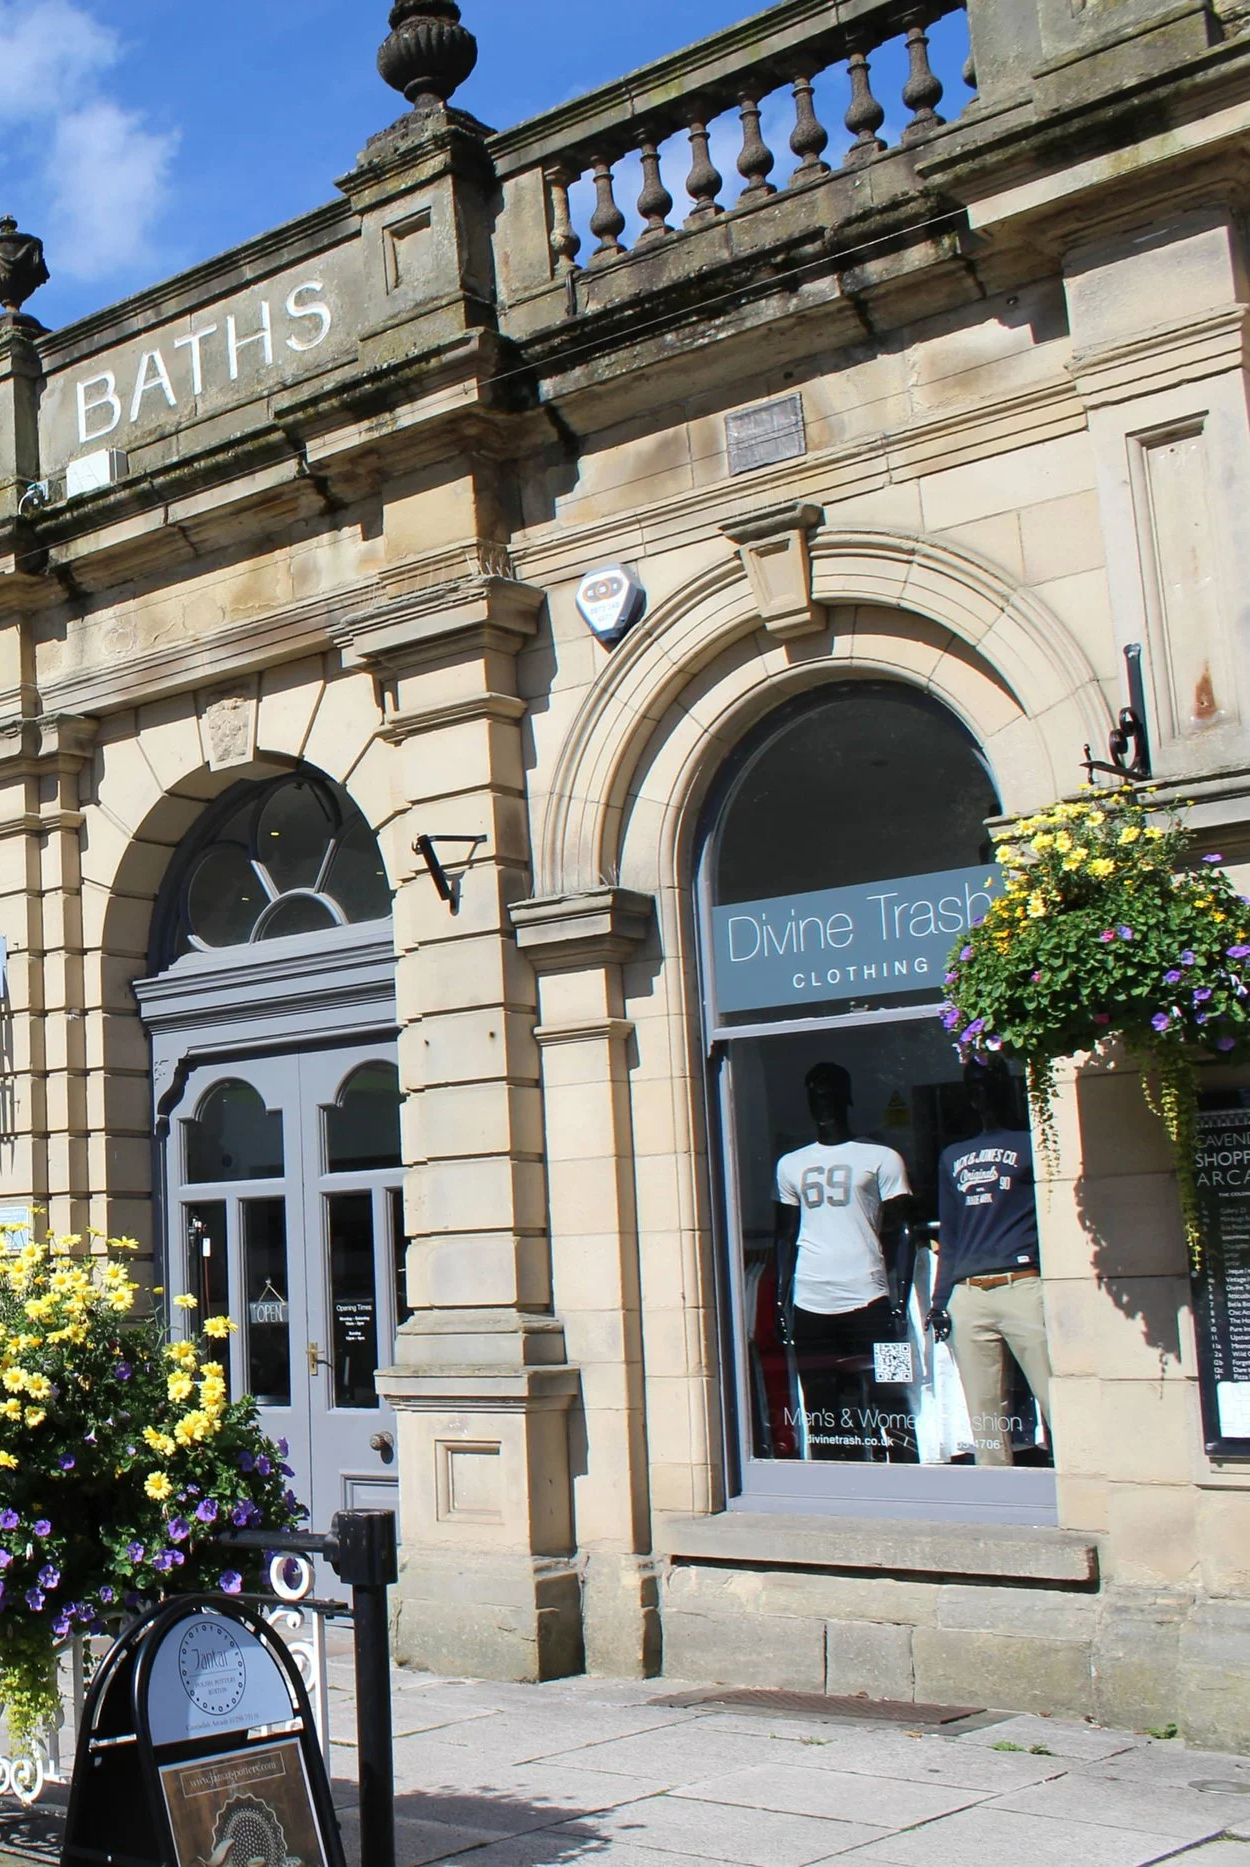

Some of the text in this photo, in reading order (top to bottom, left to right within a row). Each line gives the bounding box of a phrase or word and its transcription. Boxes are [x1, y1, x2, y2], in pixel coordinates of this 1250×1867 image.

[76, 281, 332, 443] BATHS
[728, 882, 992, 962] Divine Trash
[793, 957, 929, 988] CLOTHING
[801, 1164, 852, 1210] 69
[999, 1176, 1011, 1190] 90
[256, 1304, 283, 1323] OPEN
[336, 1304, 357, 1312] Opening
[784, 1406, 835, 1429] Men's
[841, 1408, 854, 1429] &
[971, 1411, 1023, 1433] shion
[807, 1432, 895, 1447] divinetrash.co.uk
